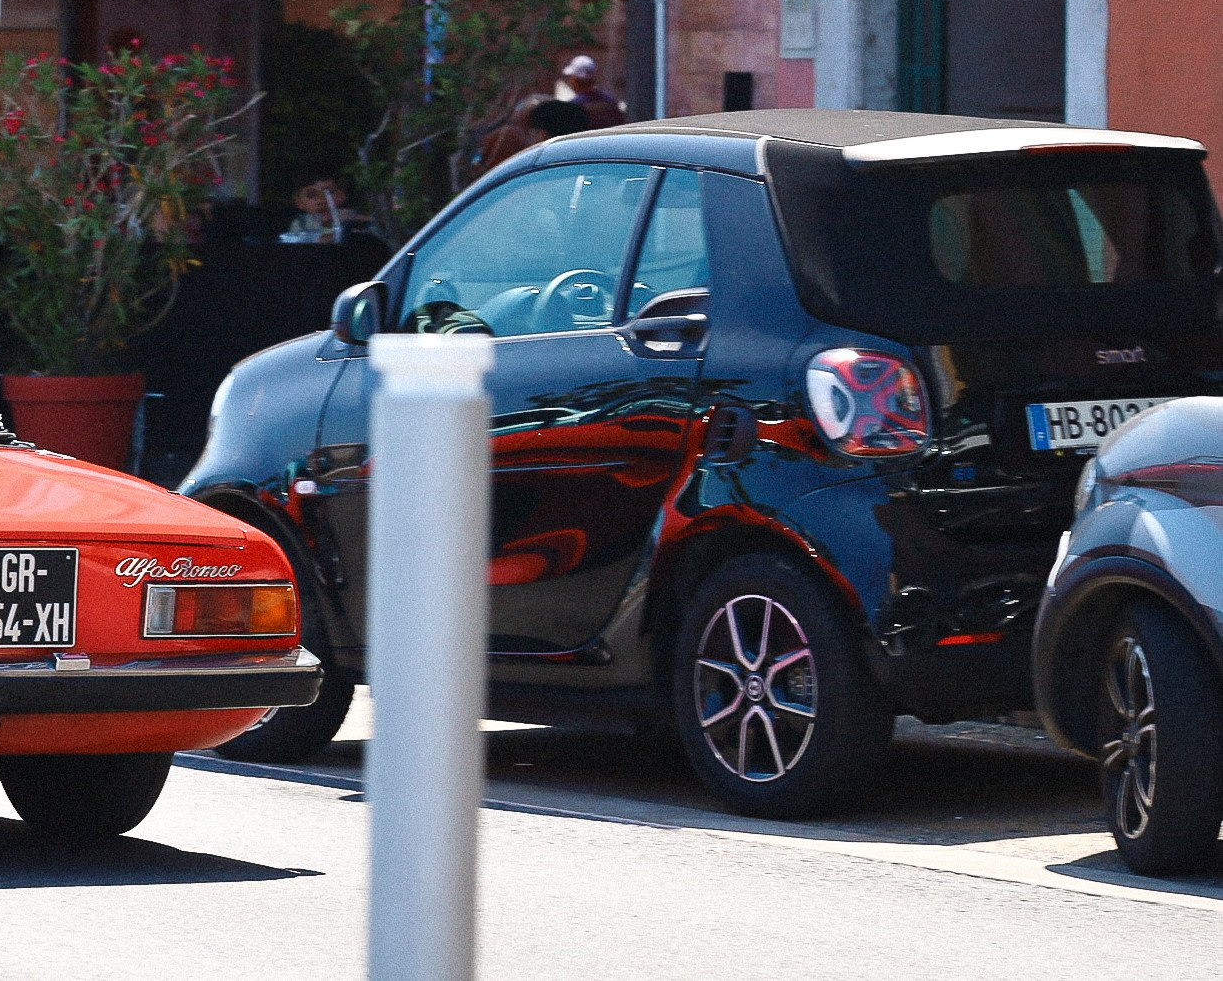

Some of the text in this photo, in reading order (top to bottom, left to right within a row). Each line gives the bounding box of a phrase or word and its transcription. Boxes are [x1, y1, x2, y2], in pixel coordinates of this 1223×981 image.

[1095, 345, 1147, 365] smart
[1047, 402, 1156, 440] HB-80
[1, 553, 48, 593] GR-
[114, 556, 243, 588] Alfa Romeo
